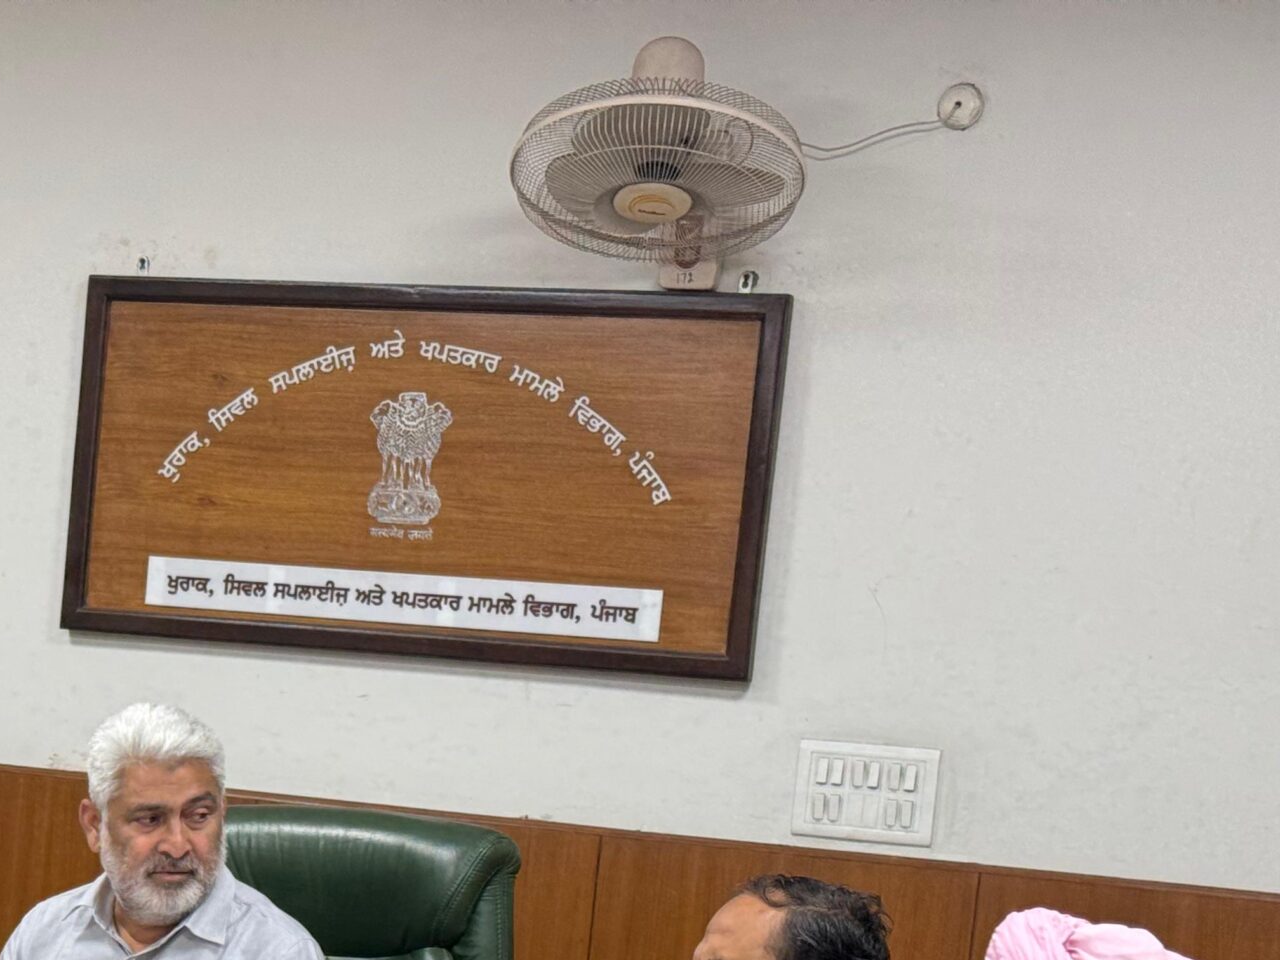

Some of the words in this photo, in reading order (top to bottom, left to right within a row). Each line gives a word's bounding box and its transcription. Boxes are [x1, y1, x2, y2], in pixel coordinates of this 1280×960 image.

[207, 387, 259, 432] ਸਿਵਲ
[370, 329, 405, 359] ਅਤੇ
[419, 340, 502, 373] ਖਪਤਕਾਰ
[509, 364, 565, 402] ਮਾਮਲੇ
[628, 451, 672, 505] ਪੰਜਾਬ
[223, 573, 268, 597] ਸਿਵਲ
[355, 584, 386, 606] ਅਤੇ
[391, 590, 463, 612] ਖਪਤਕਾਰ
[468, 592, 517, 615] ਮਾਮਲੇ
[522, 594, 581, 623] ਵਿਭਾਗ,
[591, 599, 639, 624] ਪੰਜਾਬ
